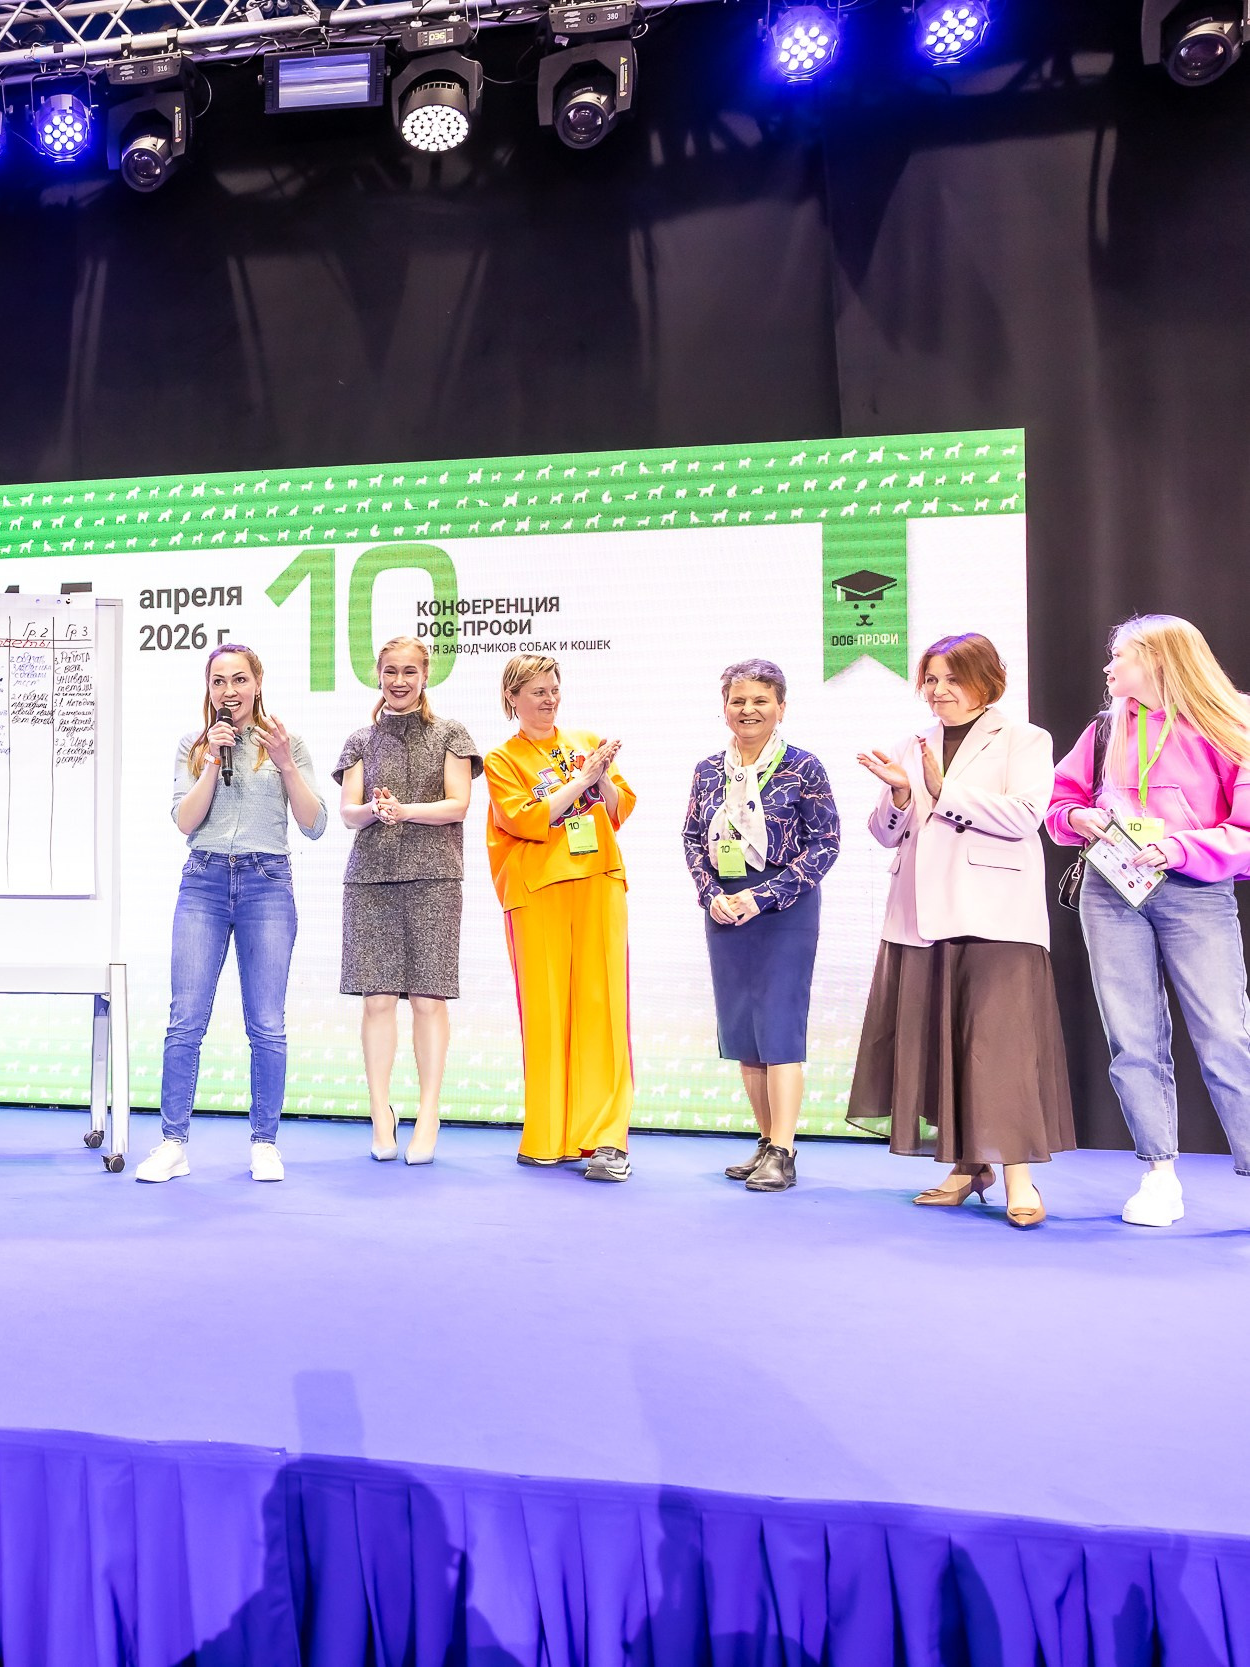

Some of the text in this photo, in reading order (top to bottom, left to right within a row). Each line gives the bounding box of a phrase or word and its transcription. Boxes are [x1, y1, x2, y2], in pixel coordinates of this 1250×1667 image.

[606, 12, 620, 21] 380
[139, 585, 243, 615] апреля
[416, 596, 561, 617] КОНФЕРЕНЦИЯ
[264, 543, 459, 692] 10
[416, 618, 532, 638] DOG-ПРОФИ
[139, 622, 208, 651] 2026
[831, 633, 899, 646] DOG-ПРОФИ
[442, 643, 517, 655] ЗАВОДЧИКОВ
[519, 641, 557, 652] СОБАК
[559, 641, 568, 651] И
[570, 639, 611, 651] КОШЕК
[568, 821, 580, 831] 10
[1127, 822, 1142, 832] 10
[720, 844, 731, 854] 10
